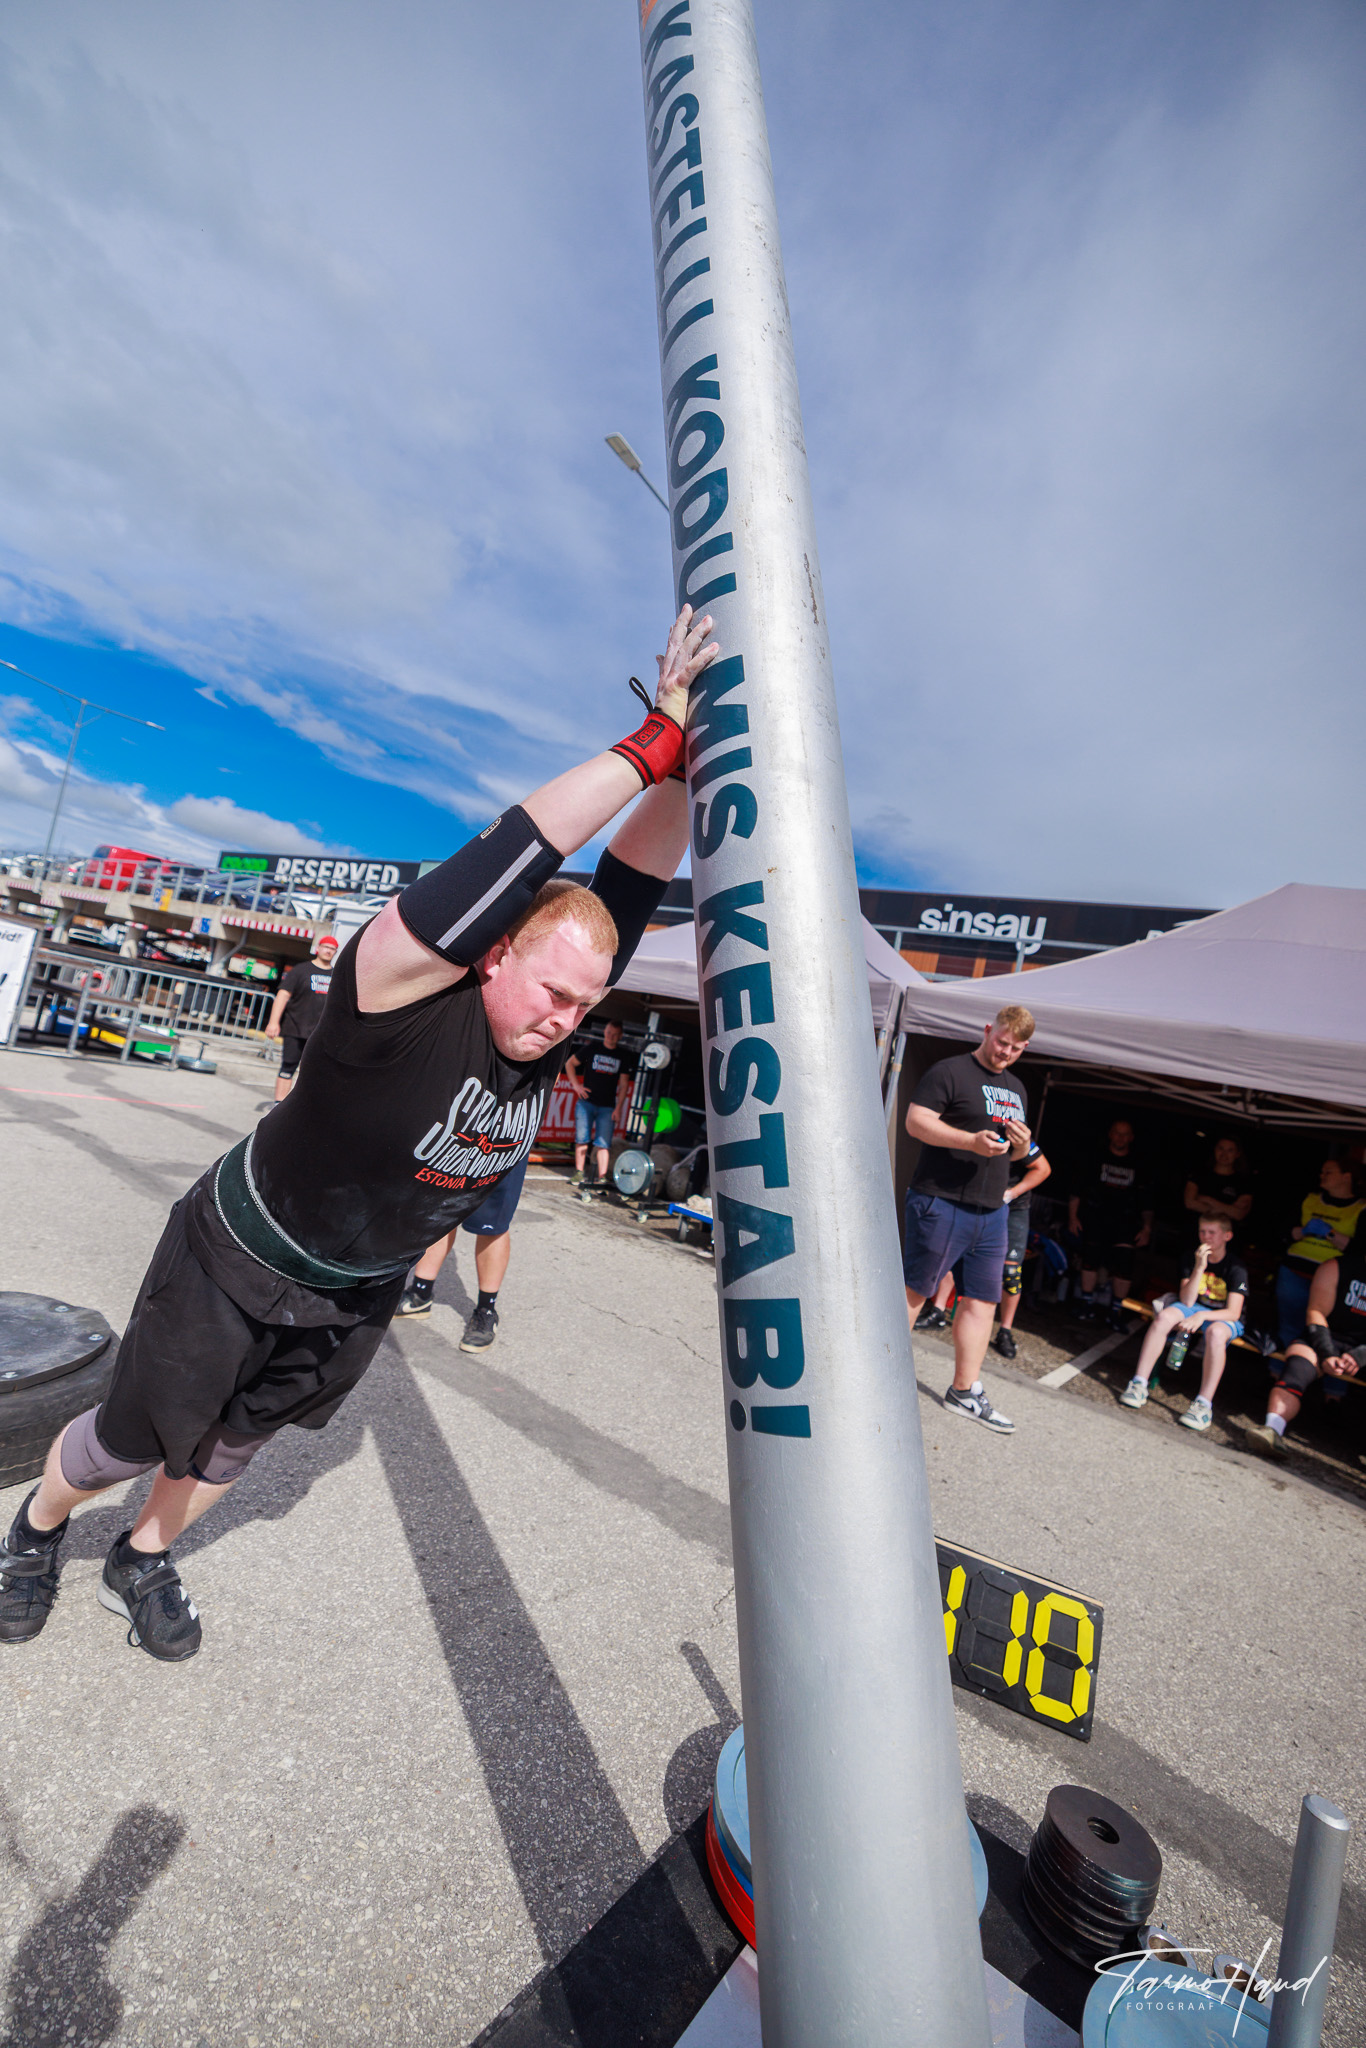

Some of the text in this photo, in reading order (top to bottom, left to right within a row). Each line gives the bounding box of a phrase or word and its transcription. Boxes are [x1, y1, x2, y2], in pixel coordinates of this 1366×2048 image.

[687, 654, 758, 860] MIS
[274, 857, 399, 892] RESERVED
[919, 903, 1047, 955] sinsay
[415, 1168, 467, 1189] ESTONIA
[699, 880, 811, 1438] KESTAB!
